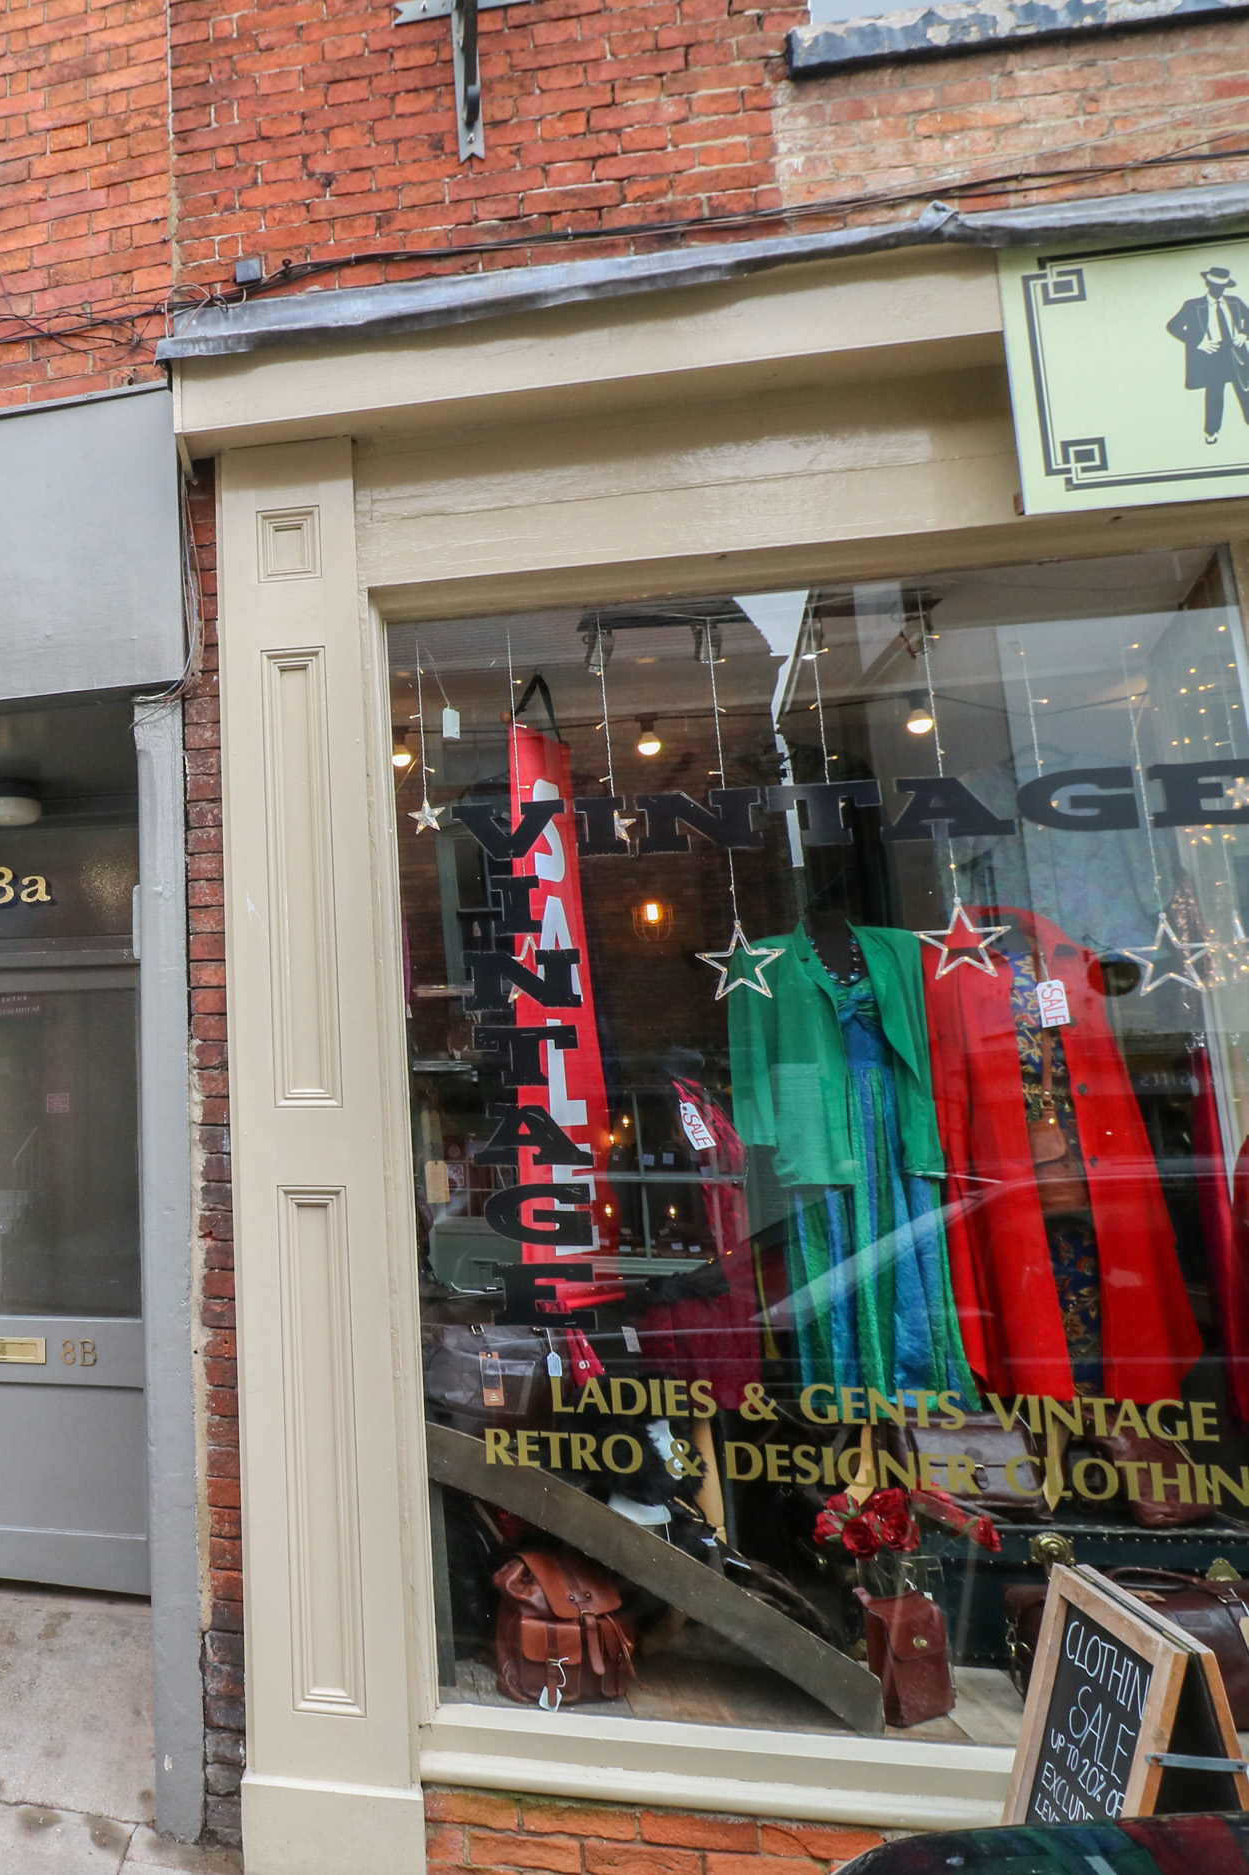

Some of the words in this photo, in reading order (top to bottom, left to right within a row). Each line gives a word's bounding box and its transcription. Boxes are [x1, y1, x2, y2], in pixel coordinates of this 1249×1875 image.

[451, 758, 1249, 860] VINTAGE
[1041, 987, 1066, 1026] SALE
[451, 798, 598, 1330] VINTAGE
[682, 1113, 714, 1147] SALE
[61, 1338, 98, 1367] 8B
[551, 1377, 717, 1419] LADIES
[739, 1382, 777, 1421] &
[799, 1383, 966, 1430] GENTS
[986, 1392, 1221, 1442] VINTAGE
[484, 1428, 644, 1474] RETRO
[665, 1439, 703, 1477] &
[724, 1441, 982, 1495] DESIGNER
[1004, 1454, 1249, 1506] CLOTHIN
[1050, 1728, 1066, 1754] UP
[1066, 1743, 1079, 1771] TO
[1077, 1758, 1107, 1802] 20%
[1069, 1686, 1136, 1784] SALE
[1041, 1761, 1094, 1820] EXCLUD
